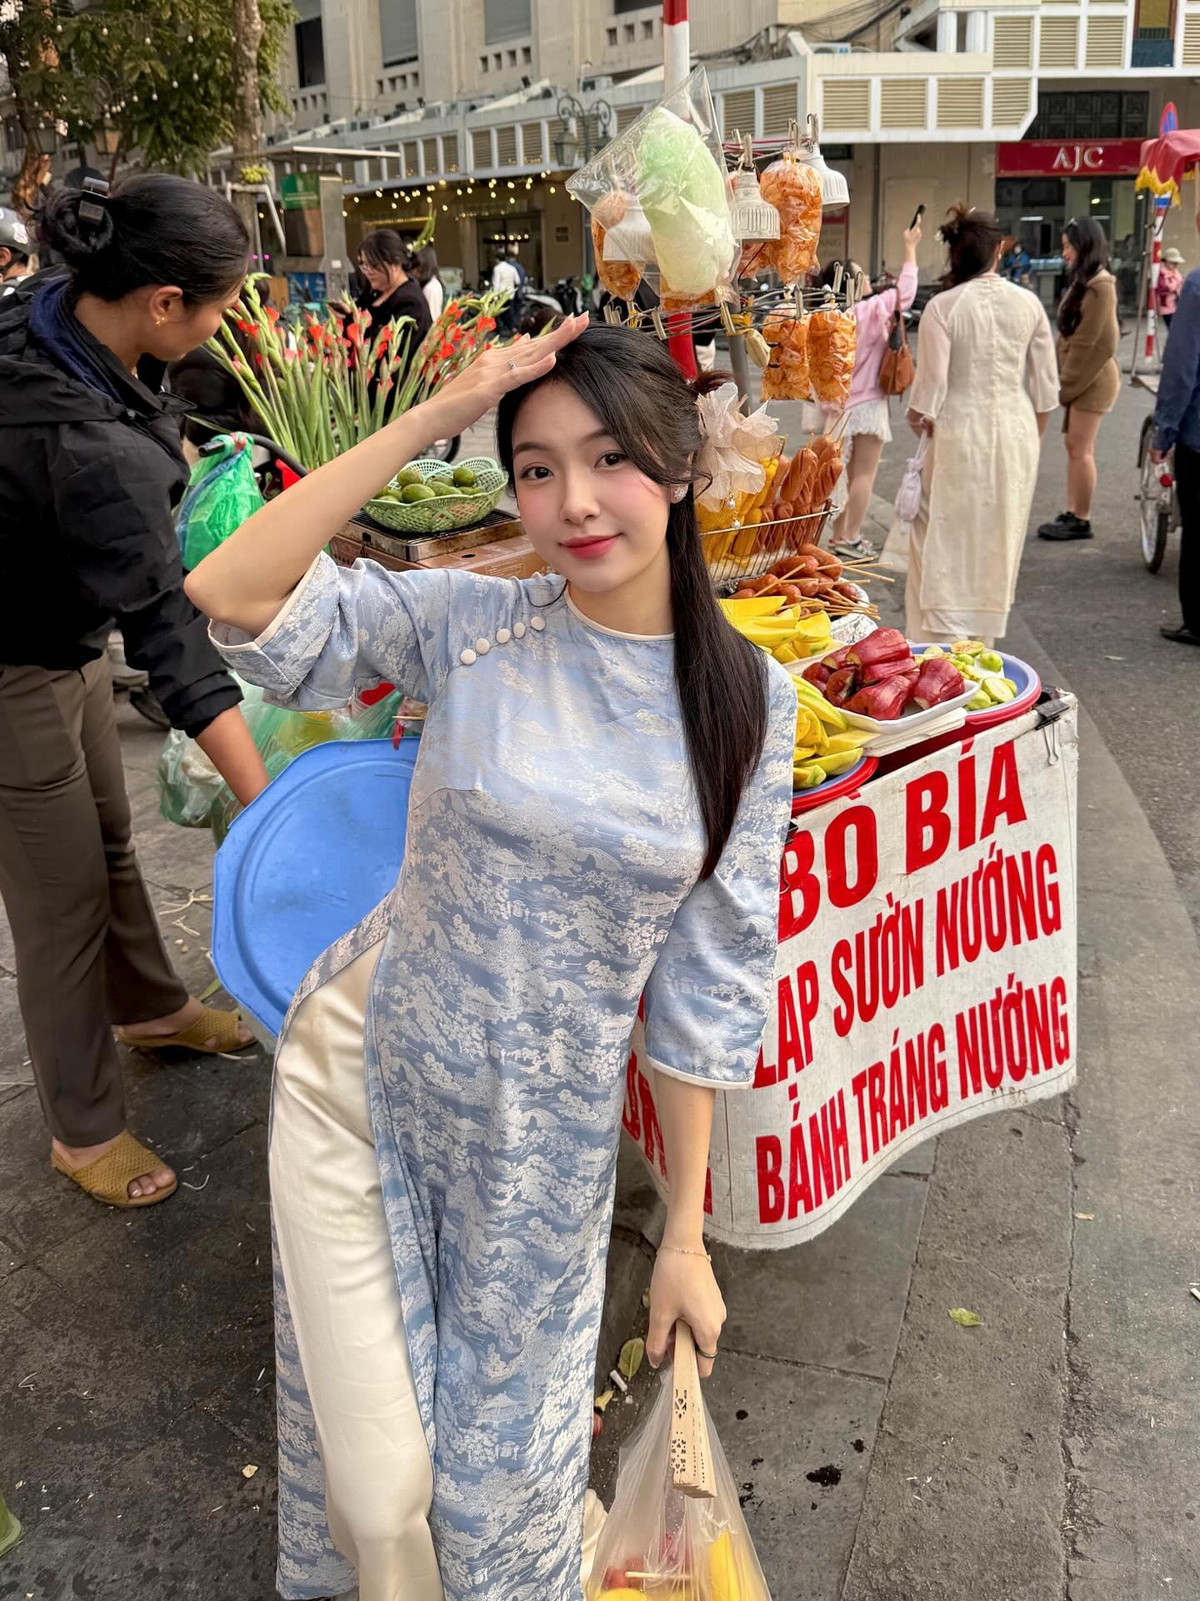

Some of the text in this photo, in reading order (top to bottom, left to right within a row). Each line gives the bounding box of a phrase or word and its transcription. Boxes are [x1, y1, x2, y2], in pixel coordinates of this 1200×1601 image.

[1052, 146, 1104, 172] AJC
[777, 736, 1027, 943] BÒ BÍA
[832, 892, 924, 1038] SƯỜN
[936, 841, 1062, 977] NƯỚNG
[755, 1102, 851, 1224] BÁNH
[851, 1028, 949, 1164] TRÁNG
[956, 973, 1070, 1100] NƯỚNG
